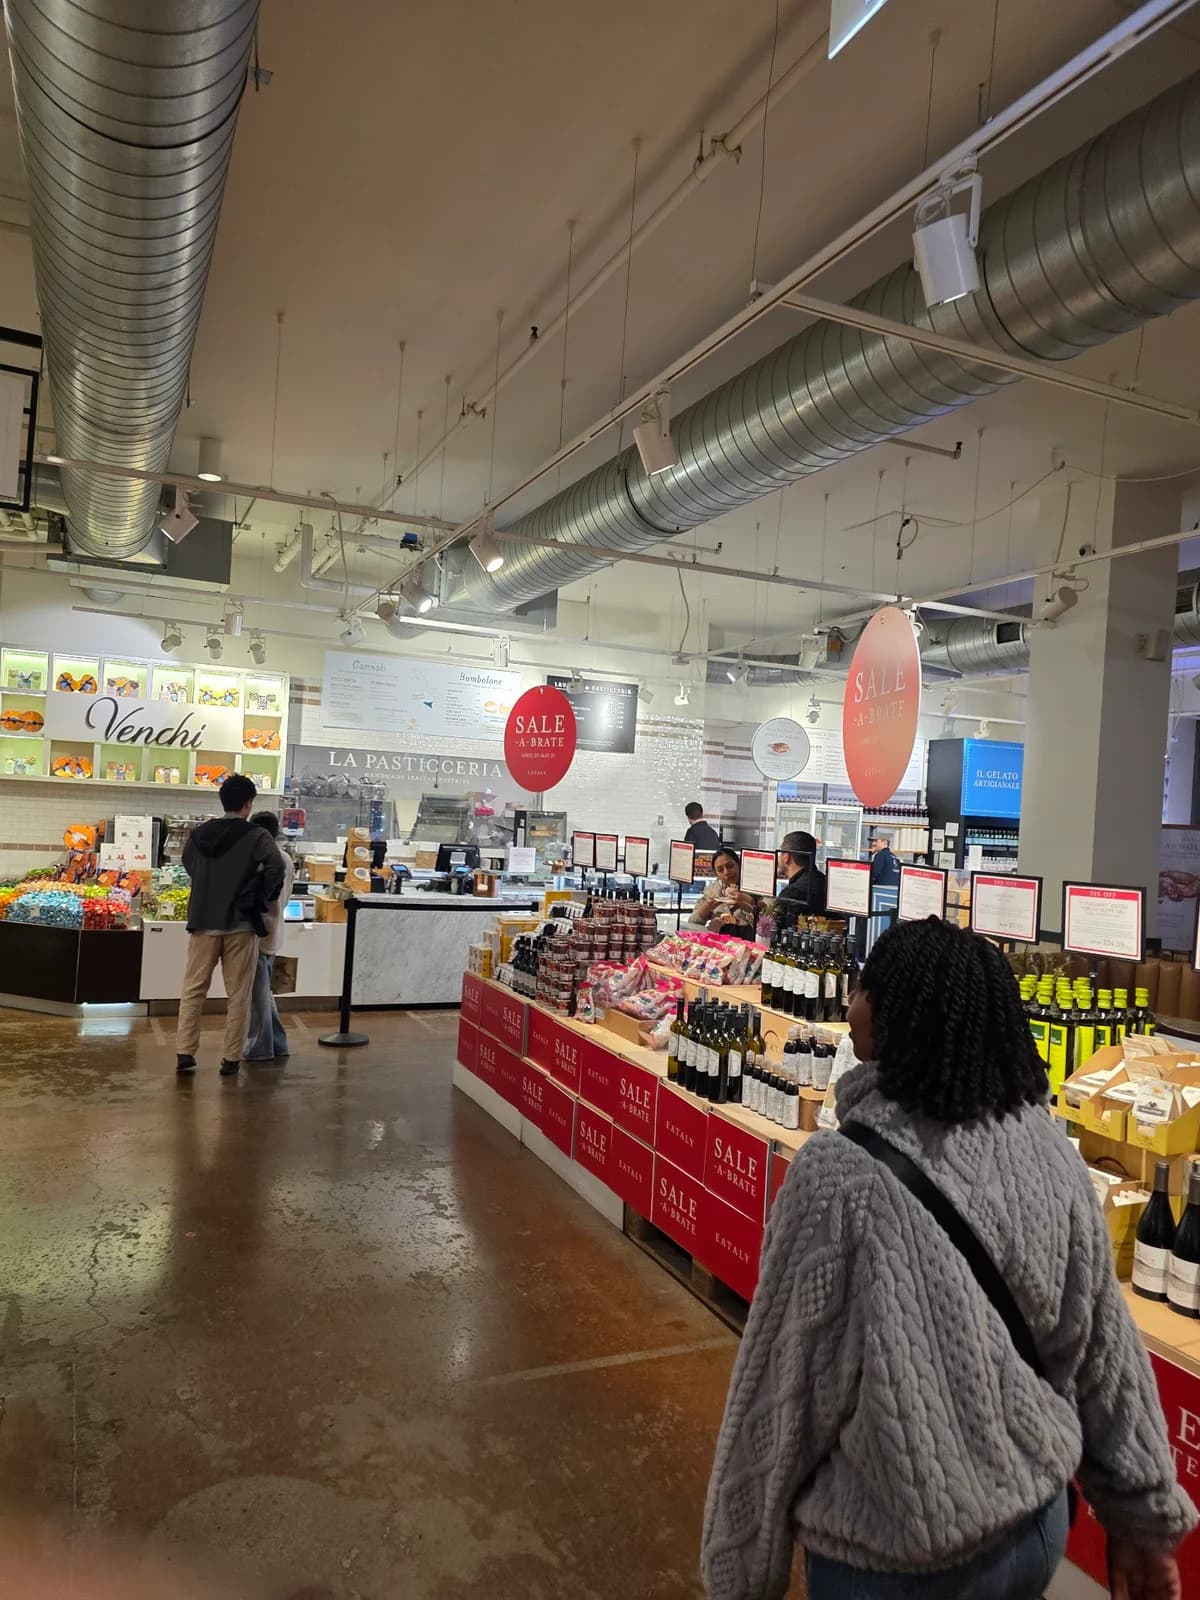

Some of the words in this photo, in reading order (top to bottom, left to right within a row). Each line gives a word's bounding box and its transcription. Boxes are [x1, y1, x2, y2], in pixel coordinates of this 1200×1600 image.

[459, 672, 503, 686] Bombolone
[855, 663, 906, 704] SALE
[85, 697, 207, 748] Venchi
[515, 714, 565, 734] SALE
[328, 751, 357, 768] LA
[365, 754, 503, 778] PASTICCERIA
[976, 769, 984, 778] IL
[986, 770, 1019, 780] GELATO
[503, 1007, 521, 1029] SALE
[480, 1044, 496, 1065] SALE
[555, 1039, 577, 1065] SALE
[522, 1076, 543, 1102] SALE
[619, 1078, 651, 1110] SALE
[580, 1120, 607, 1153] SALE
[665, 1121, 695, 1148] EATALY
[618, 1160, 643, 1184] EATALY
[713, 1137, 758, 1182] SALE
[713, 1164, 757, 1198] -A-BRATE
[659, 1177, 697, 1222] SALE
[715, 1232, 751, 1265] EATALY
